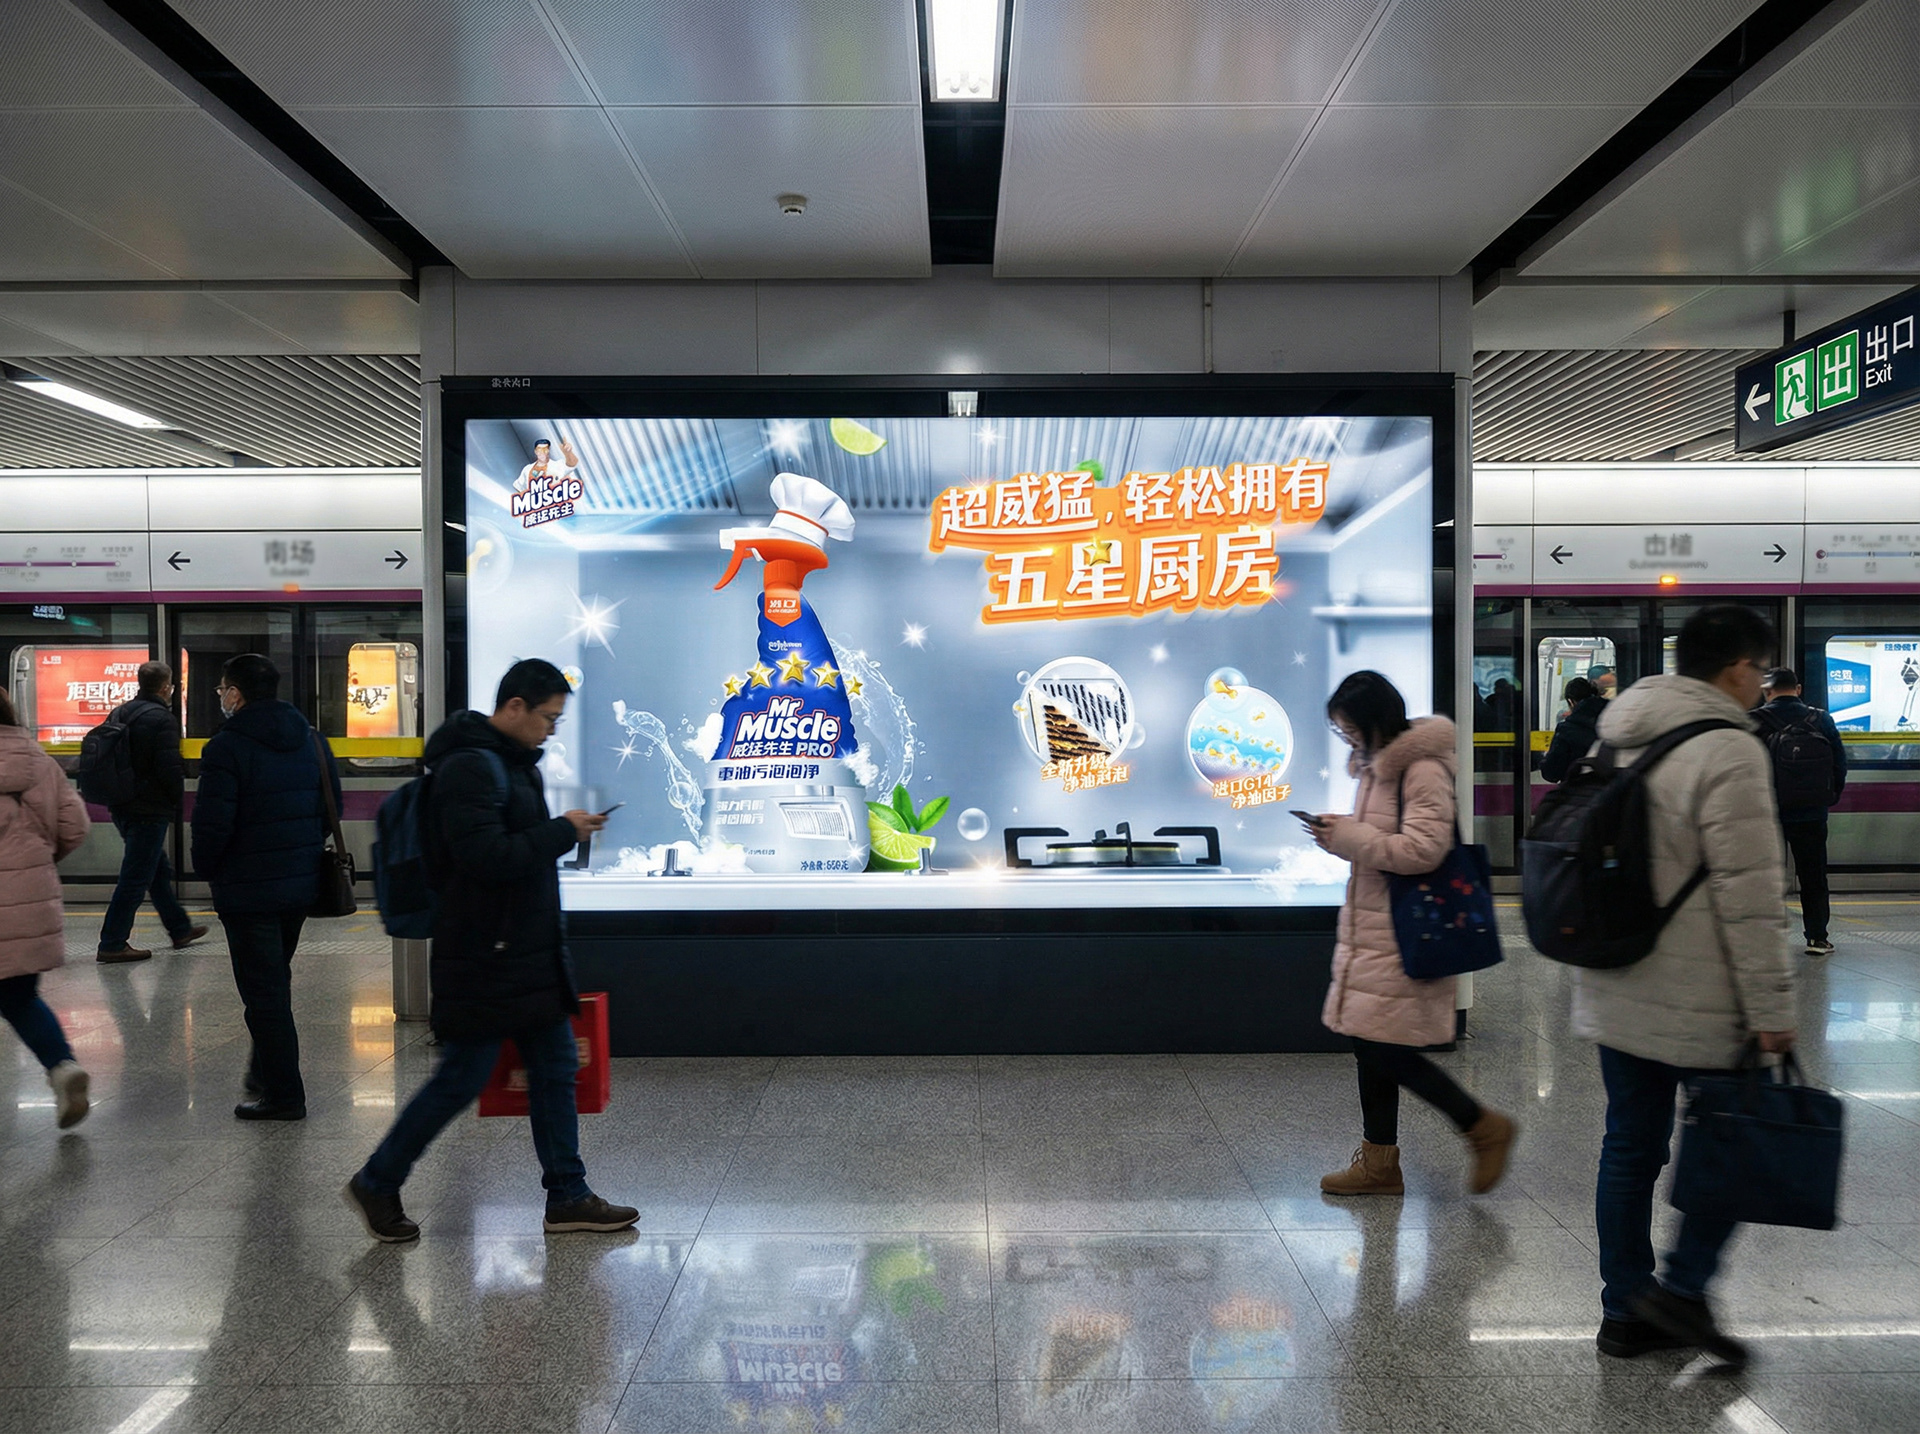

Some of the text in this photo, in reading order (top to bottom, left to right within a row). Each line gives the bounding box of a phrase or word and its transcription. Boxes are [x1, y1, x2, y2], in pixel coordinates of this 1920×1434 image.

[1865, 314, 1915, 366] 出口
[1822, 344, 1852, 400] 出
[1865, 363, 1893, 389] Exit
[513, 480, 581, 515] Muscle
[530, 476, 553, 494] Mr
[990, 526, 1280, 613] 五星厨房
[769, 698, 801, 717] Mr
[736, 712, 839, 742] Muscle
[796, 742, 833, 757] PRO
